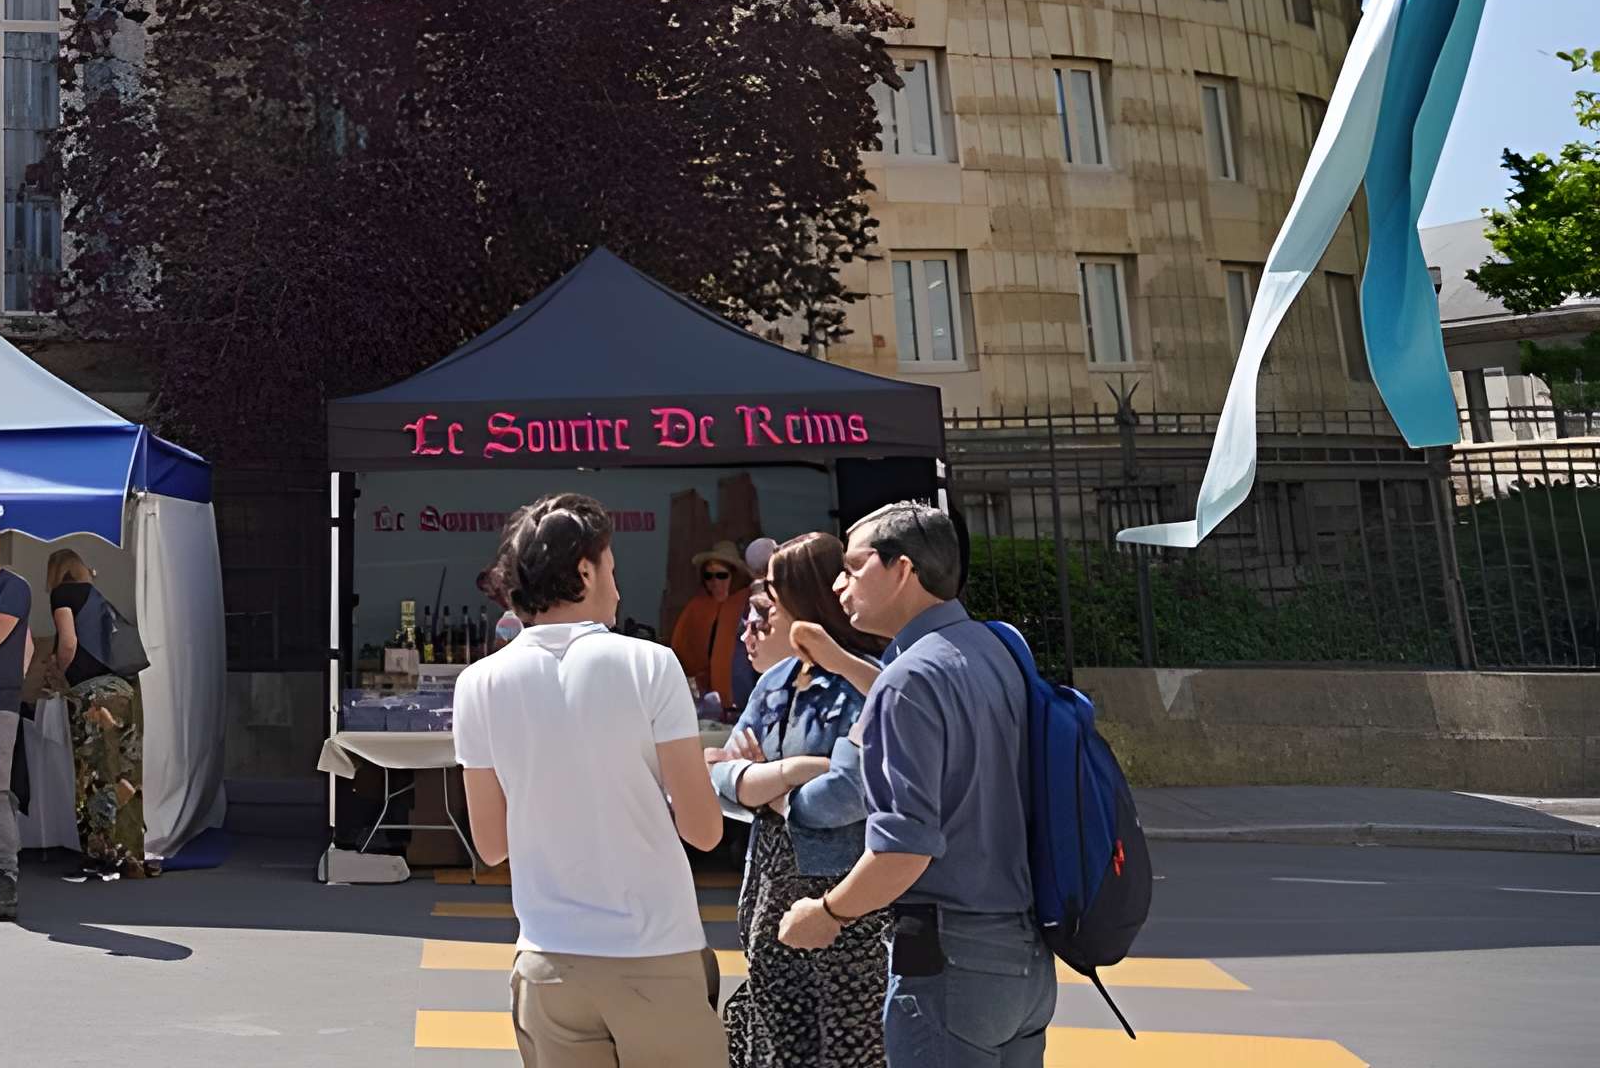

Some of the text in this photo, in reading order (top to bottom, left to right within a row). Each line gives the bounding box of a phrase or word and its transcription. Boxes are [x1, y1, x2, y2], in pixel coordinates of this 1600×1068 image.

[403, 404, 870, 459] Le Sourire De Reims
